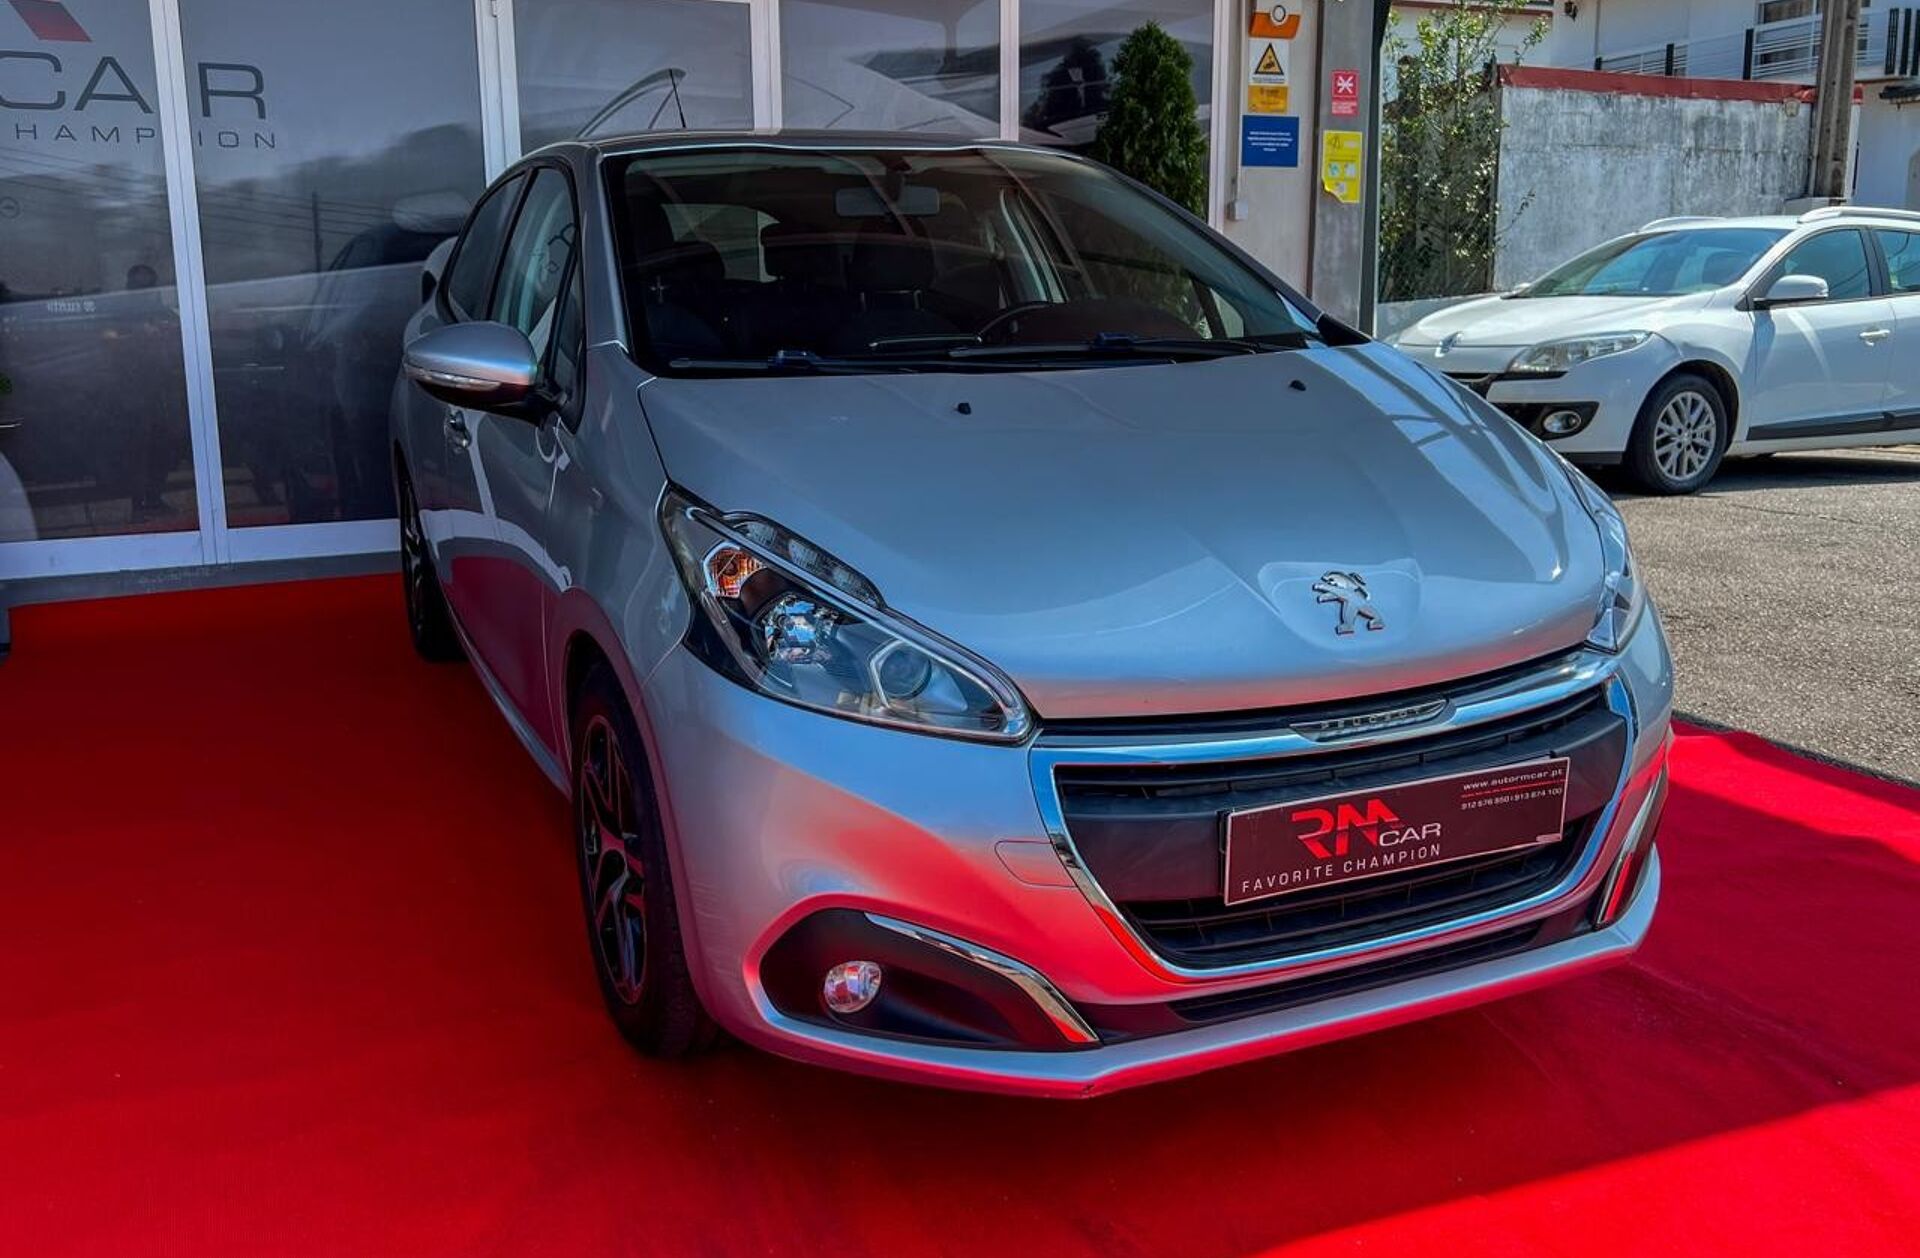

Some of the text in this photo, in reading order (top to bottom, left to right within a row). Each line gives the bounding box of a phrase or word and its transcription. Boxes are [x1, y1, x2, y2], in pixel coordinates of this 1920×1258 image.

[15, 123, 276, 149] HAMPION
[1463, 768, 1563, 791] www.autormcar.pt
[1379, 822, 1442, 847] CAR
[1242, 843, 1441, 894] FAVORITE CHAMPION
